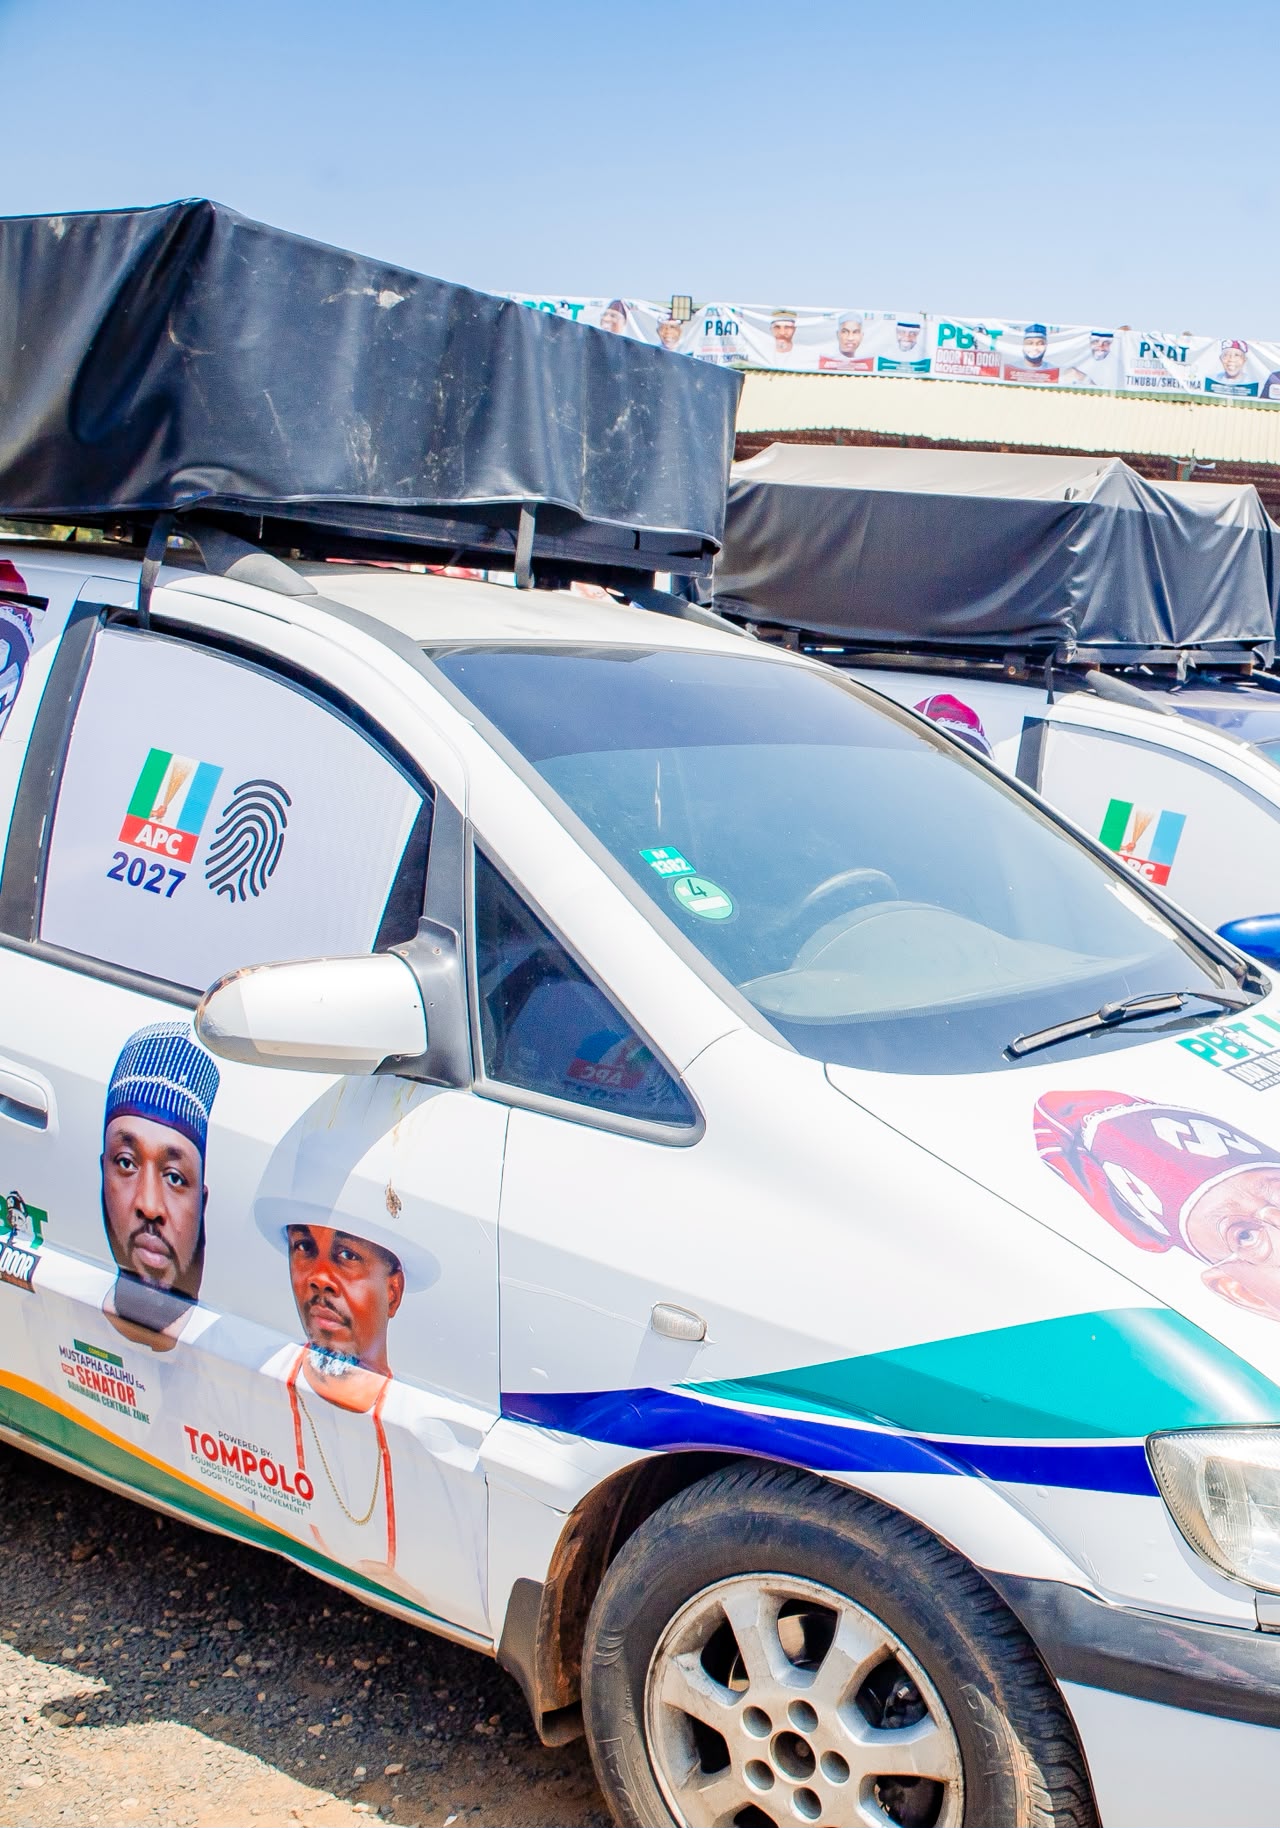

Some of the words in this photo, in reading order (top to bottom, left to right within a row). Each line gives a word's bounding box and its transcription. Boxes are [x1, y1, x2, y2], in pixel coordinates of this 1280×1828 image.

[134, 824, 183, 855] APC
[106, 851, 187, 898] 2027
[59, 1345, 103, 1373] MUSTAPHA
[104, 1364, 134, 1386] SALIHU
[76, 1364, 136, 1407] SENATOR
[218, 1430, 259, 1453] POWERED
[184, 1425, 314, 1501] TOMPOLO
[200, 1466, 223, 1481] DOOR
[224, 1476, 235, 1487] TO
[236, 1481, 258, 1496] DOOR
[260, 1492, 305, 1515] MOVEMENT
[257, 1482, 290, 1500] PATRON
